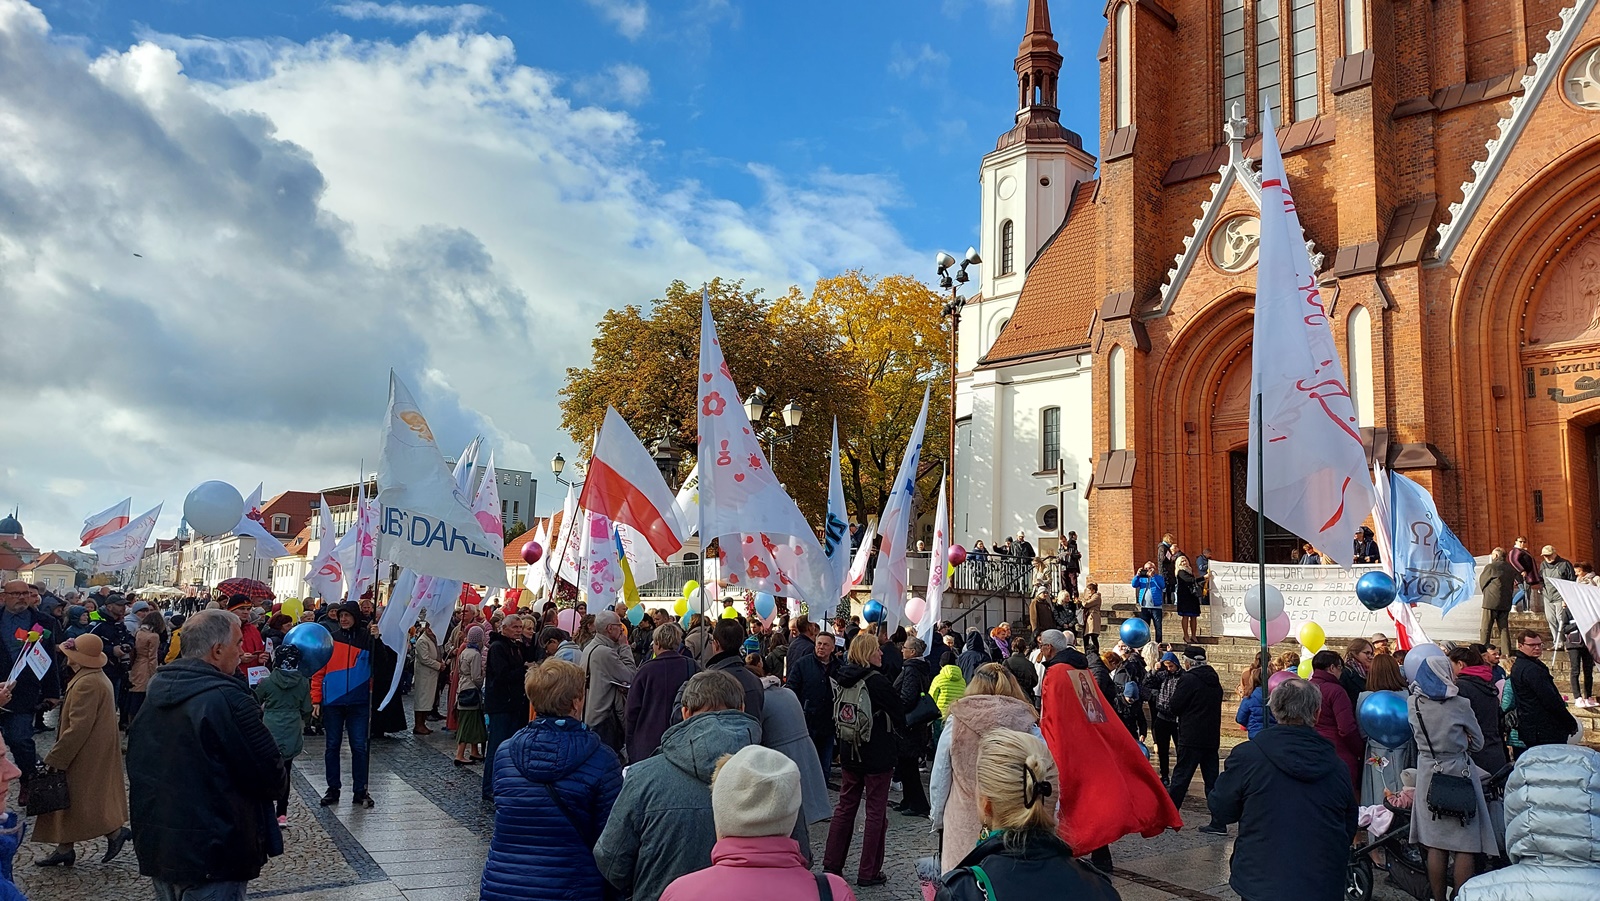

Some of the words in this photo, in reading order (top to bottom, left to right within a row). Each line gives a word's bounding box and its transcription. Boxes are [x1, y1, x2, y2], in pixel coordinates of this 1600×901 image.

[1283, 567, 1304, 580] DAR
[1313, 567, 1329, 580] OD
[1324, 582, 1356, 592] ZABIJ
[1323, 595, 1361, 607] RODZI
[1222, 612, 1251, 624] RODZ
[1328, 610, 1379, 623] BOGIEM
